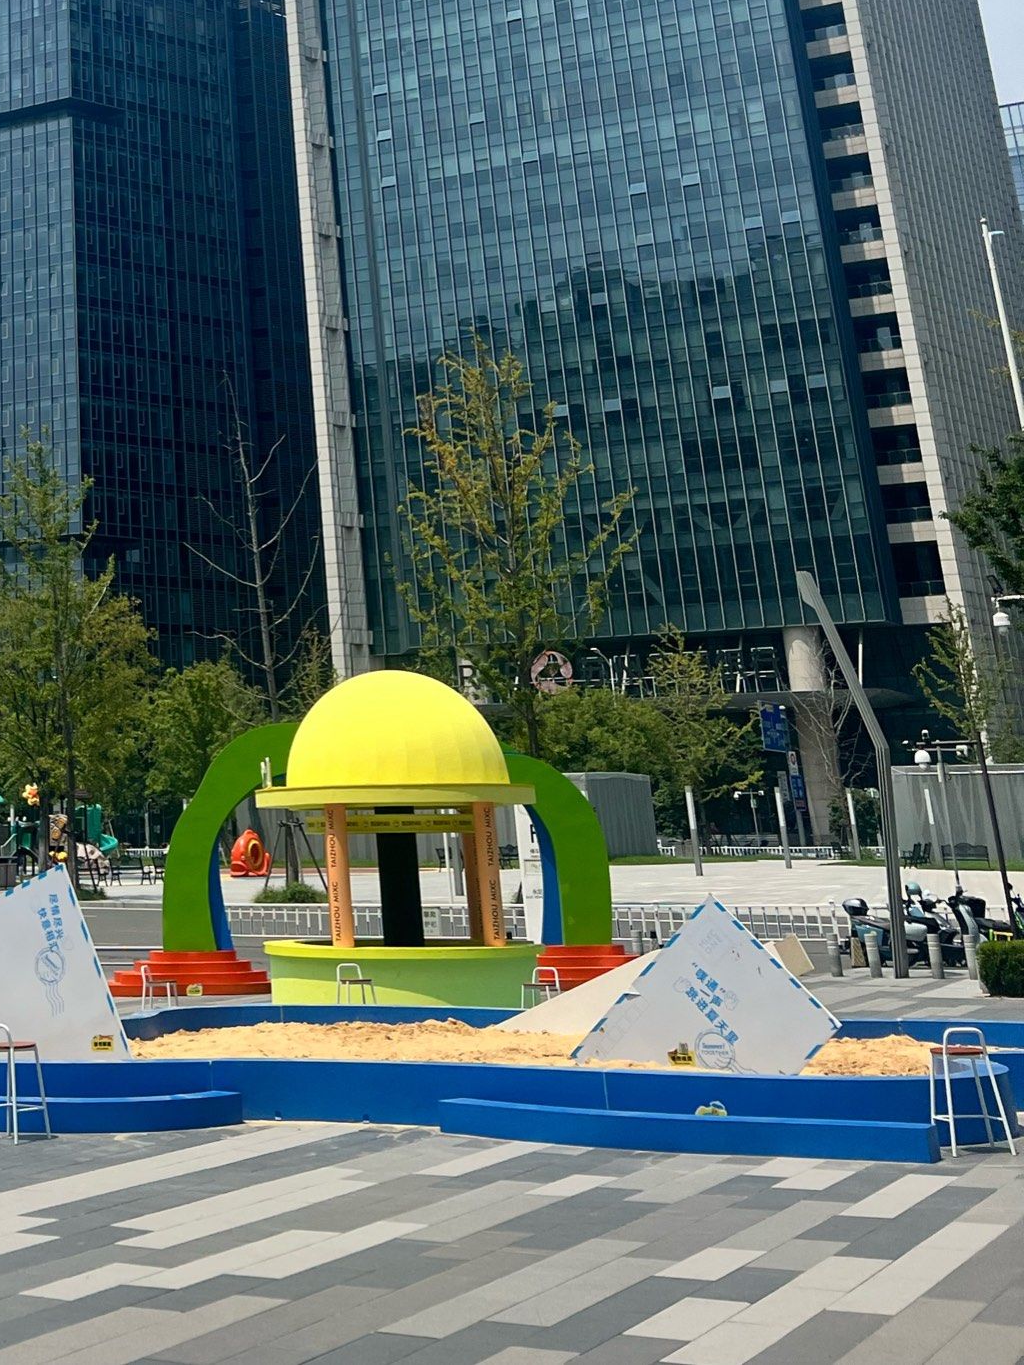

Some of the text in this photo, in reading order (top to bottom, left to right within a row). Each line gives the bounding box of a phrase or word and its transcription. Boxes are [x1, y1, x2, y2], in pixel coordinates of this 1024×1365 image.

[37, 907, 60, 953] 快意相汇
[48, 894, 64, 940] 尽情尽兴
[334, 906, 342, 942] TAIZHOU
[492, 904, 500, 941] TAIZHOU
[685, 986, 739, 1045] 跳进夏天里
[699, 988, 724, 1007] 一声
